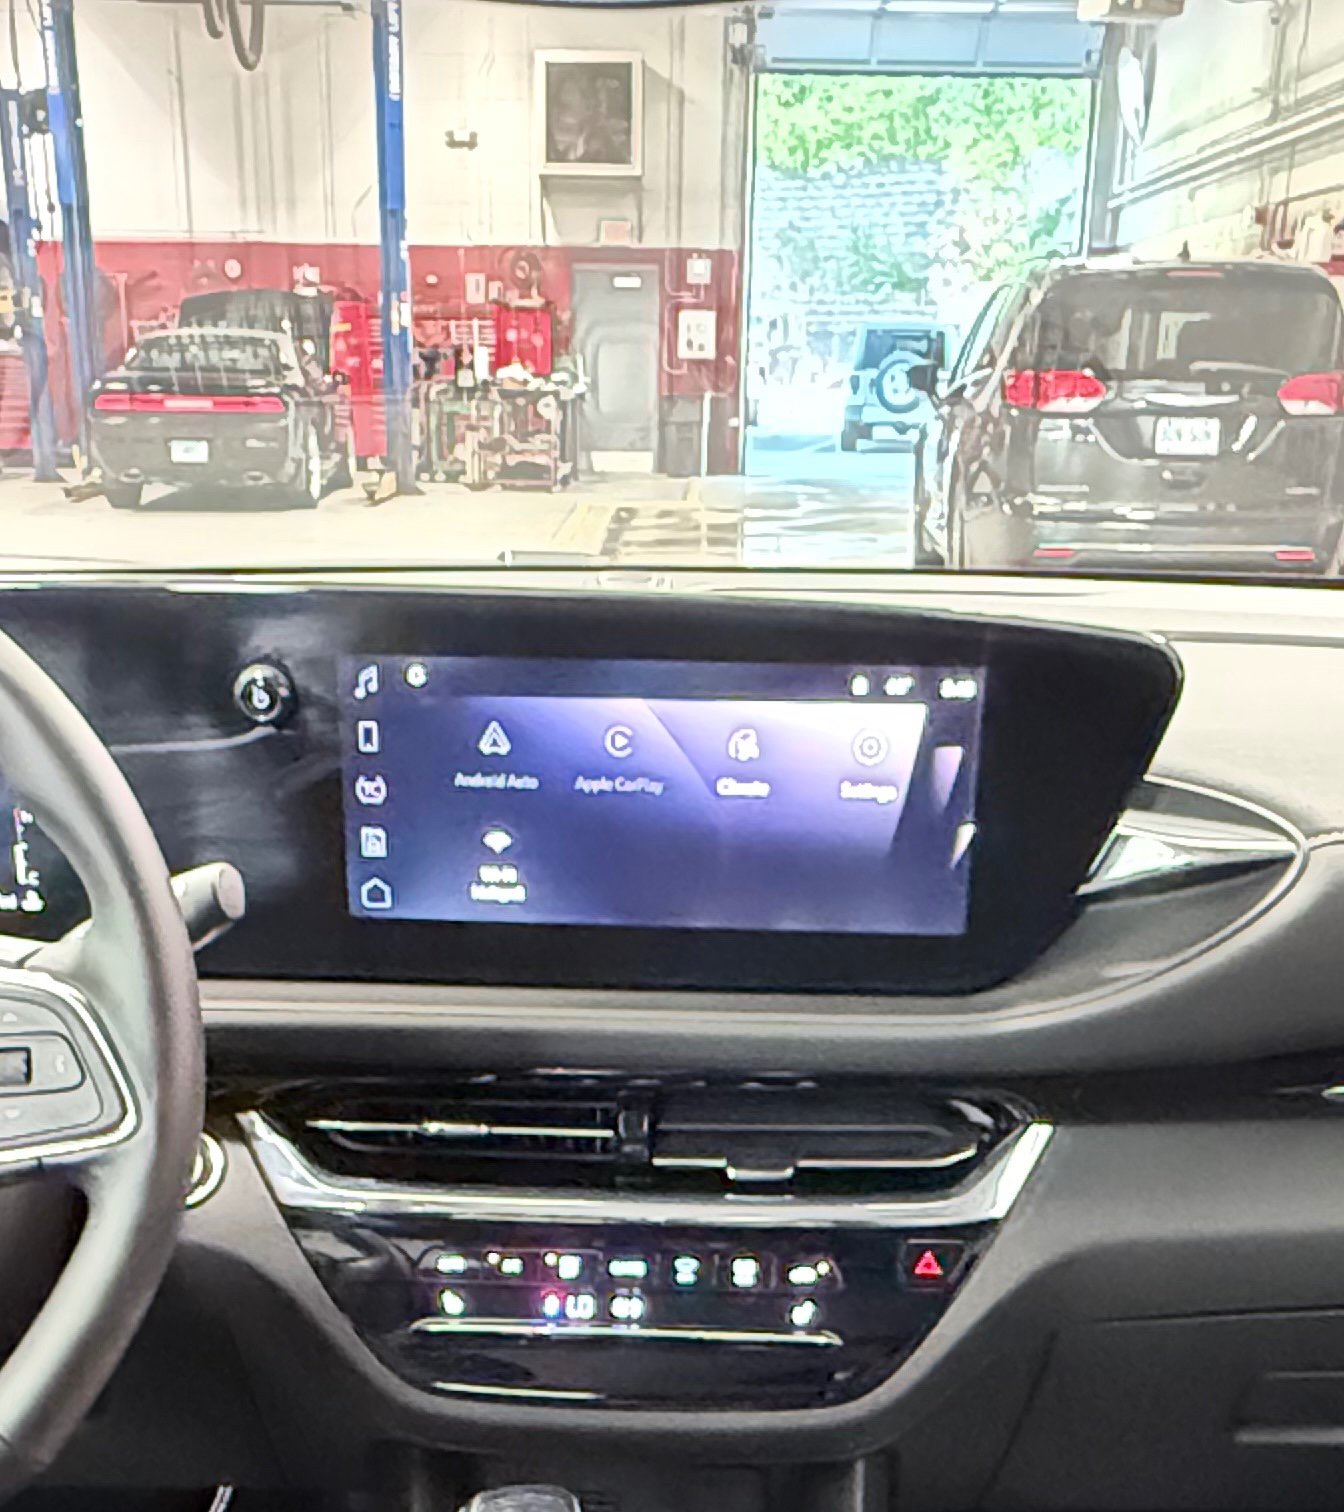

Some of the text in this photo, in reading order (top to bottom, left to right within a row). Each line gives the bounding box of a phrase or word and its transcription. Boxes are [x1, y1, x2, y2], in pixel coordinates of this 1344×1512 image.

[454, 772, 540, 790] Android Auto
[575, 776, 614, 795] Apple
